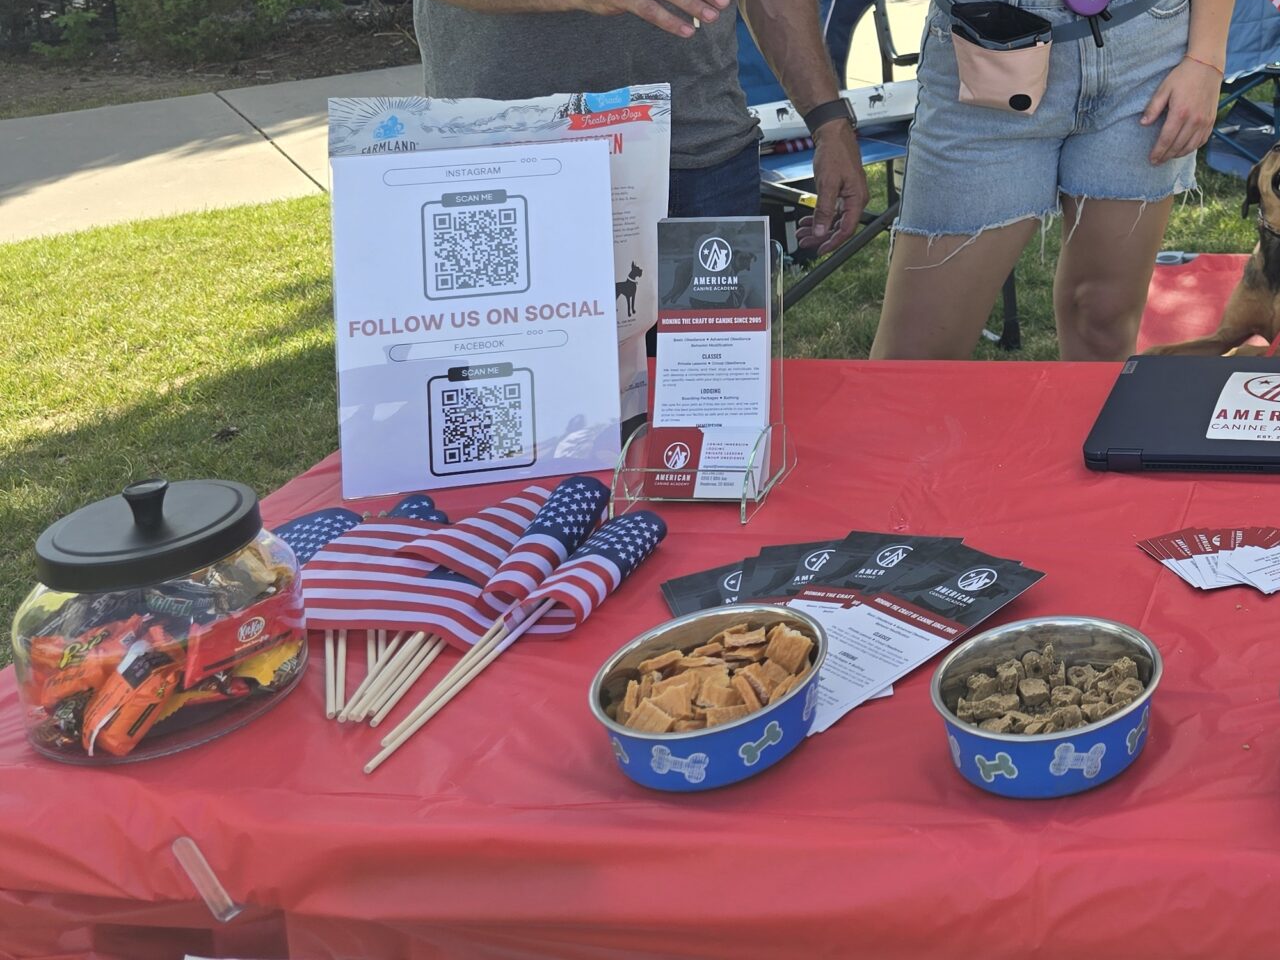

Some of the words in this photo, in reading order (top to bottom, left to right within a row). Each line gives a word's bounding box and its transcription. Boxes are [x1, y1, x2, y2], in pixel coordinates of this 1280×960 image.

[582, 114, 607, 128] Treats
[606, 113, 621, 125] for
[620, 108, 642, 122] Dogs
[445, 166, 502, 178] INSTAGRAM
[455, 194, 479, 204] SCAN
[480, 193, 494, 202] ME
[693, 276, 738, 286] AMERICAN
[349, 313, 445, 338] FOLLOW
[450, 310, 481, 329] US
[486, 306, 519, 326] ON
[524, 300, 605, 322] SOCIAL
[454, 339, 505, 352] FACEBOOK
[461, 368, 486, 377] SCAN
[487, 366, 499, 375] ME
[1211, 423, 1267, 432] CANINE
[858, 568, 885, 576] AMER
[934, 585, 976, 604] AMERICAN
